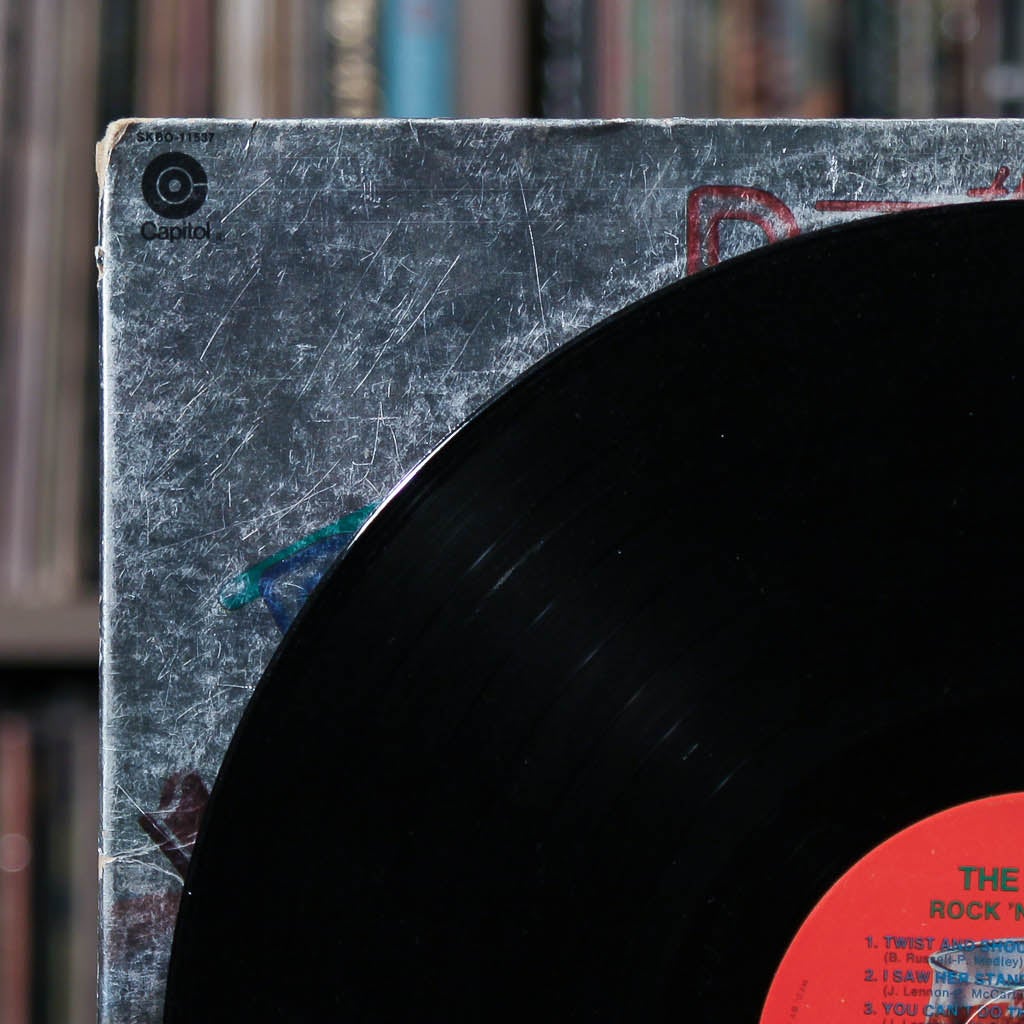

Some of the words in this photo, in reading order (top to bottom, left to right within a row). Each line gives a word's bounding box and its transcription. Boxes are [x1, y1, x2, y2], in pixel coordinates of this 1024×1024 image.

[136, 131, 215, 142] SKBO-11537
[141, 221, 211, 242] Capitol
[958, 865, 1019, 892] THE
[929, 900, 1001, 921] ROCK
[864, 936, 878, 949] 1.
[884, 936, 934, 950] TWIST
[940, 937, 976, 951] AND
[864, 969, 878, 982] 2.
[892, 970, 930, 983] SAW
[935, 971, 969, 985] HER
[863, 1002, 877, 1015] 3.
[881, 1002, 919, 1016] YOU
[977, 1005, 1002, 1019] DO
